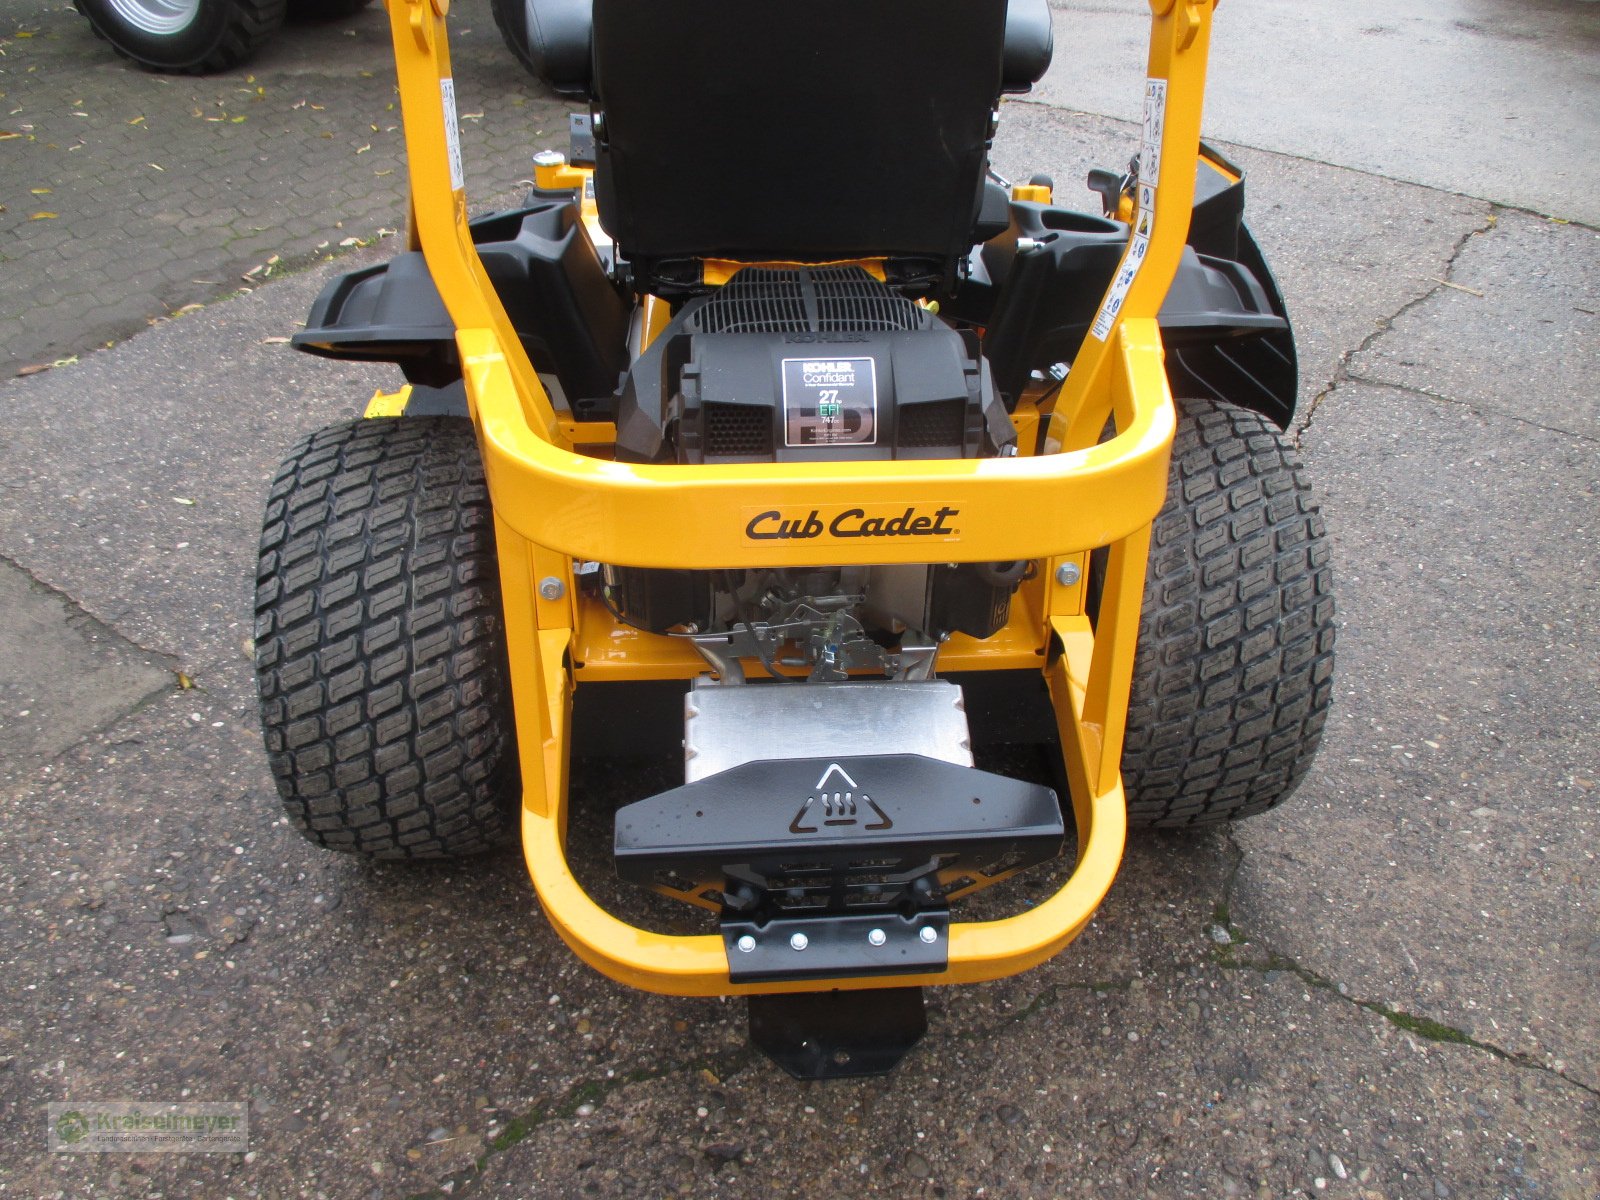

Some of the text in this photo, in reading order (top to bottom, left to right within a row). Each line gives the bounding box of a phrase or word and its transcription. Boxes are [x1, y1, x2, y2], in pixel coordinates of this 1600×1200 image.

[785, 334, 869, 344] KOHLER
[803, 362, 855, 373] KOHLER
[803, 373, 855, 382] Confidant
[819, 404, 839, 416] EFI
[745, 506, 960, 540] Cub Cadet
